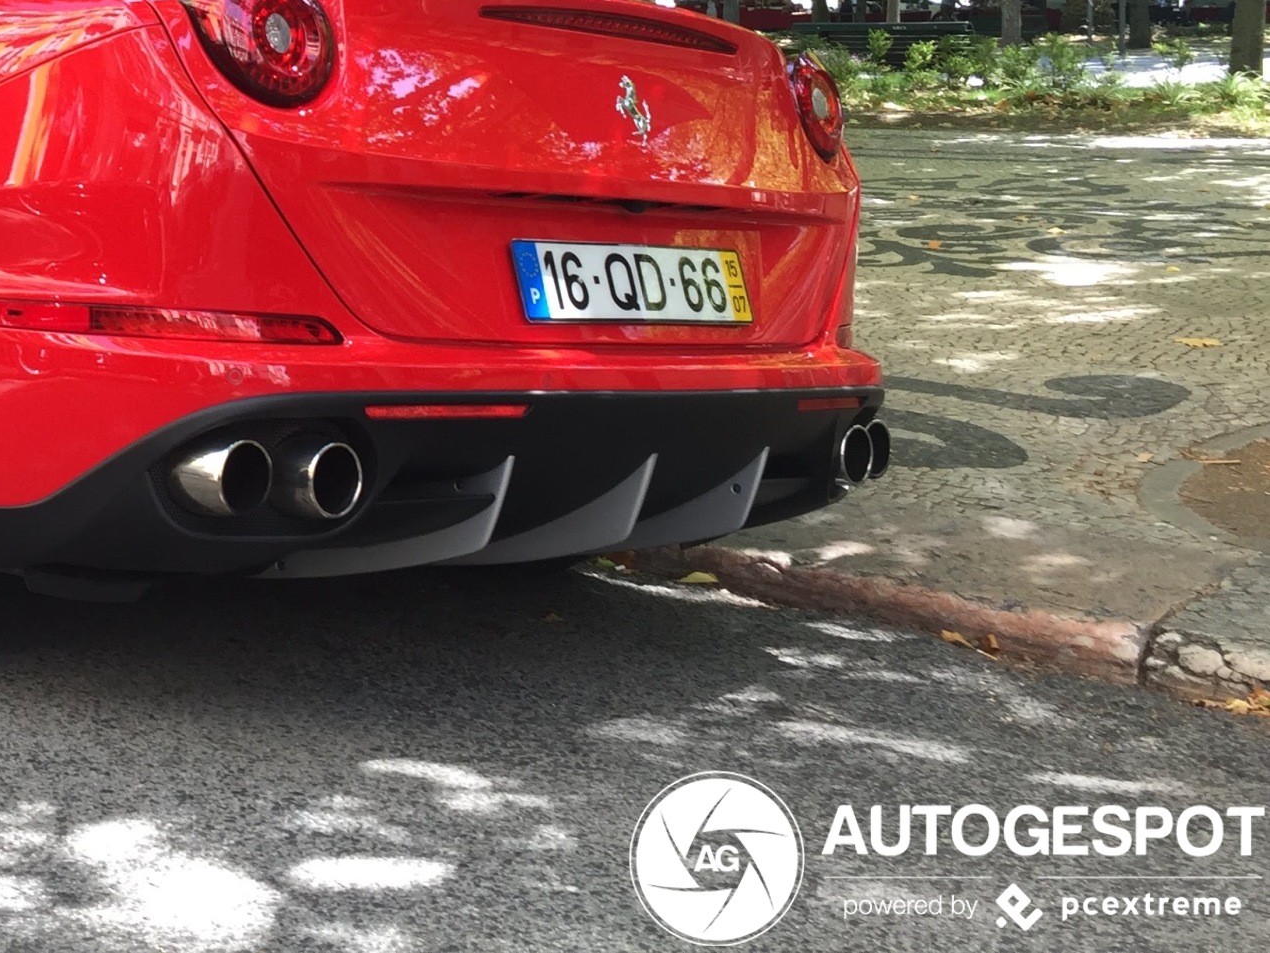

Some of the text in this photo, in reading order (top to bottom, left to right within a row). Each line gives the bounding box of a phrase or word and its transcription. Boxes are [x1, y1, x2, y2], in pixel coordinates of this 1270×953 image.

[725, 259, 738, 278] 15
[530, 288, 541, 304] P
[732, 296, 749, 313] 07
